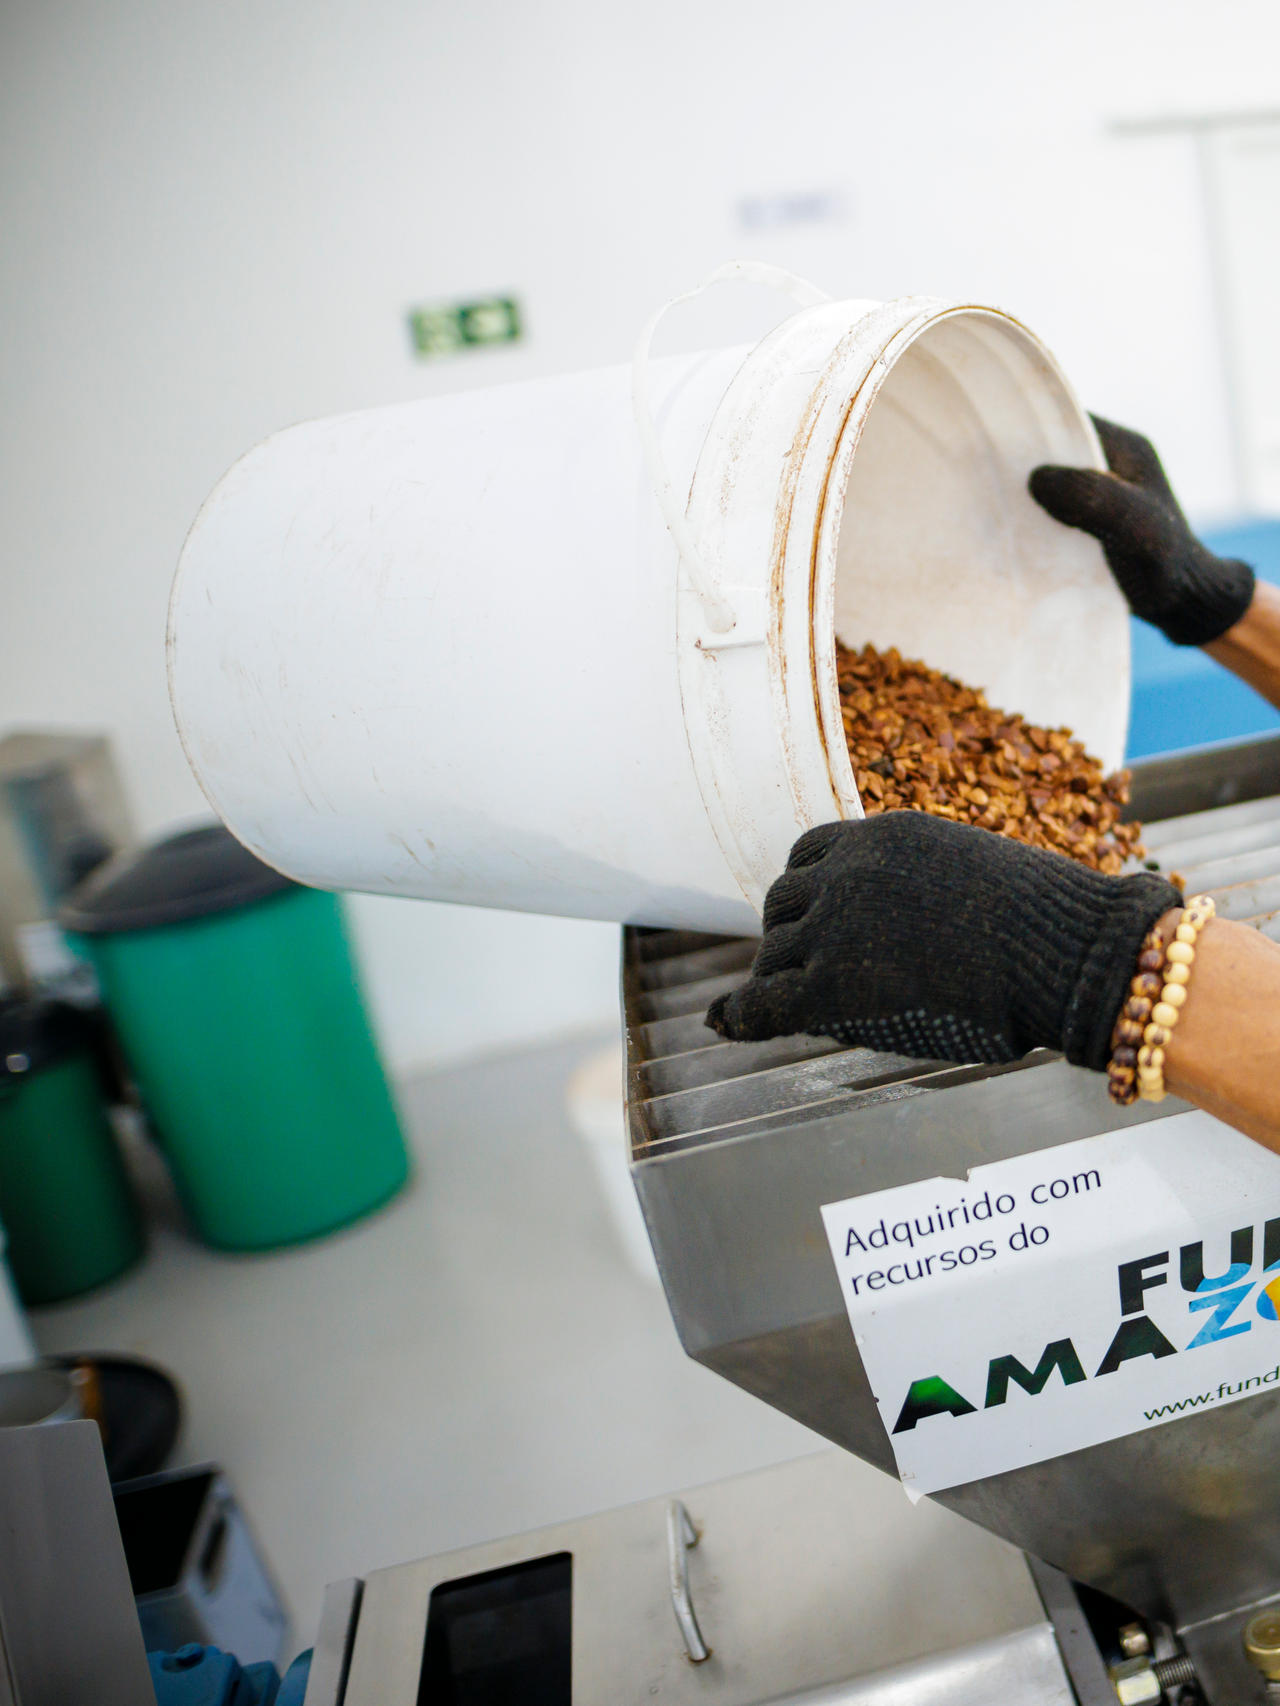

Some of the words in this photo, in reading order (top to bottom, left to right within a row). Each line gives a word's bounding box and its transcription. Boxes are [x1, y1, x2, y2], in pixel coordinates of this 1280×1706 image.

[844, 1191, 1016, 1257] Adquirido
[1030, 1168, 1102, 1205] com
[850, 1239, 997, 1296] recursos
[1008, 1222, 1050, 1252] do
